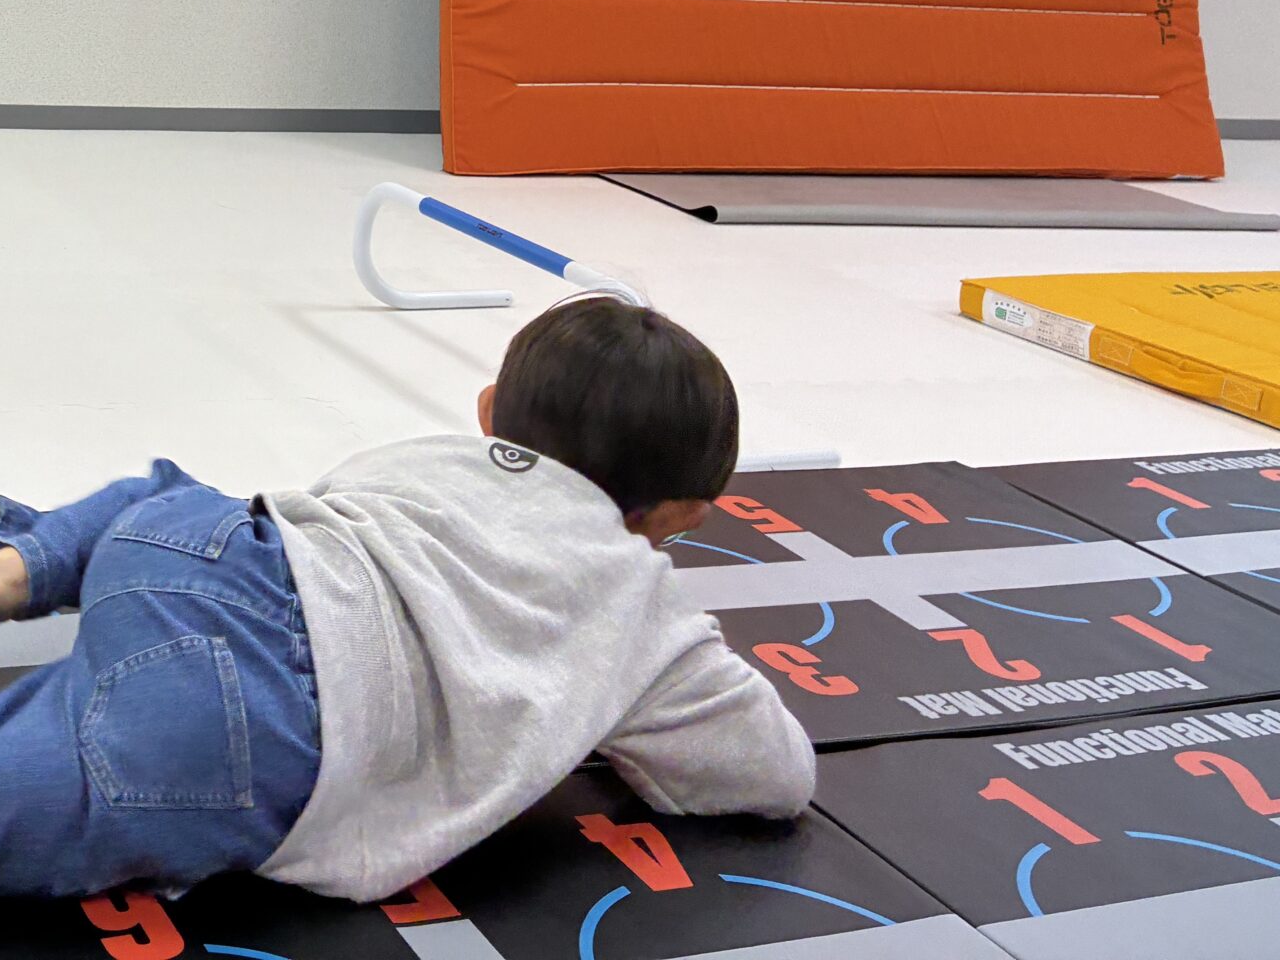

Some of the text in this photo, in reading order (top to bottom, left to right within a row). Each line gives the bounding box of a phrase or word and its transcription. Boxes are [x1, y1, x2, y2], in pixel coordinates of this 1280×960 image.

[713, 495, 804, 533] 5
[862, 488, 950, 525] 4
[1126, 477, 1212, 509] 1
[926, 628, 1042, 681] 2
[1109, 614, 1213, 663] 1
[752, 642, 860, 697] 3
[897, 666, 1209, 721] Functional Mat
[993, 716, 1232, 771] Functional
[977, 777, 1102, 845] 1
[574, 813, 694, 892] 4
